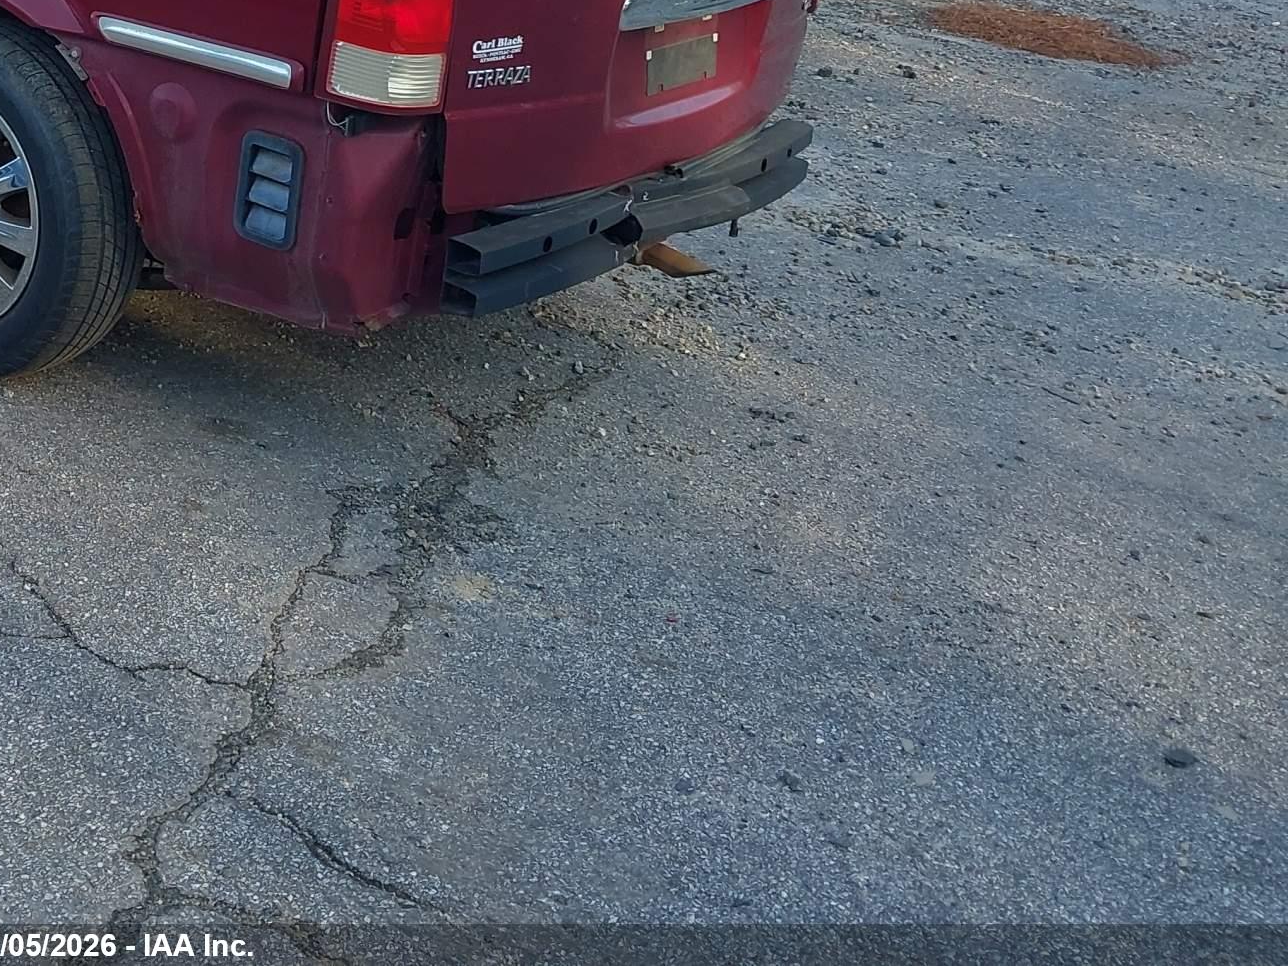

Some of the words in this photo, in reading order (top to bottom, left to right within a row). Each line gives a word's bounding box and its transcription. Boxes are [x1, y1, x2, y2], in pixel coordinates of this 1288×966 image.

[472, 39, 496, 54] Carl
[497, 35, 524, 48] Black
[467, 65, 532, 89] TERRAZA
